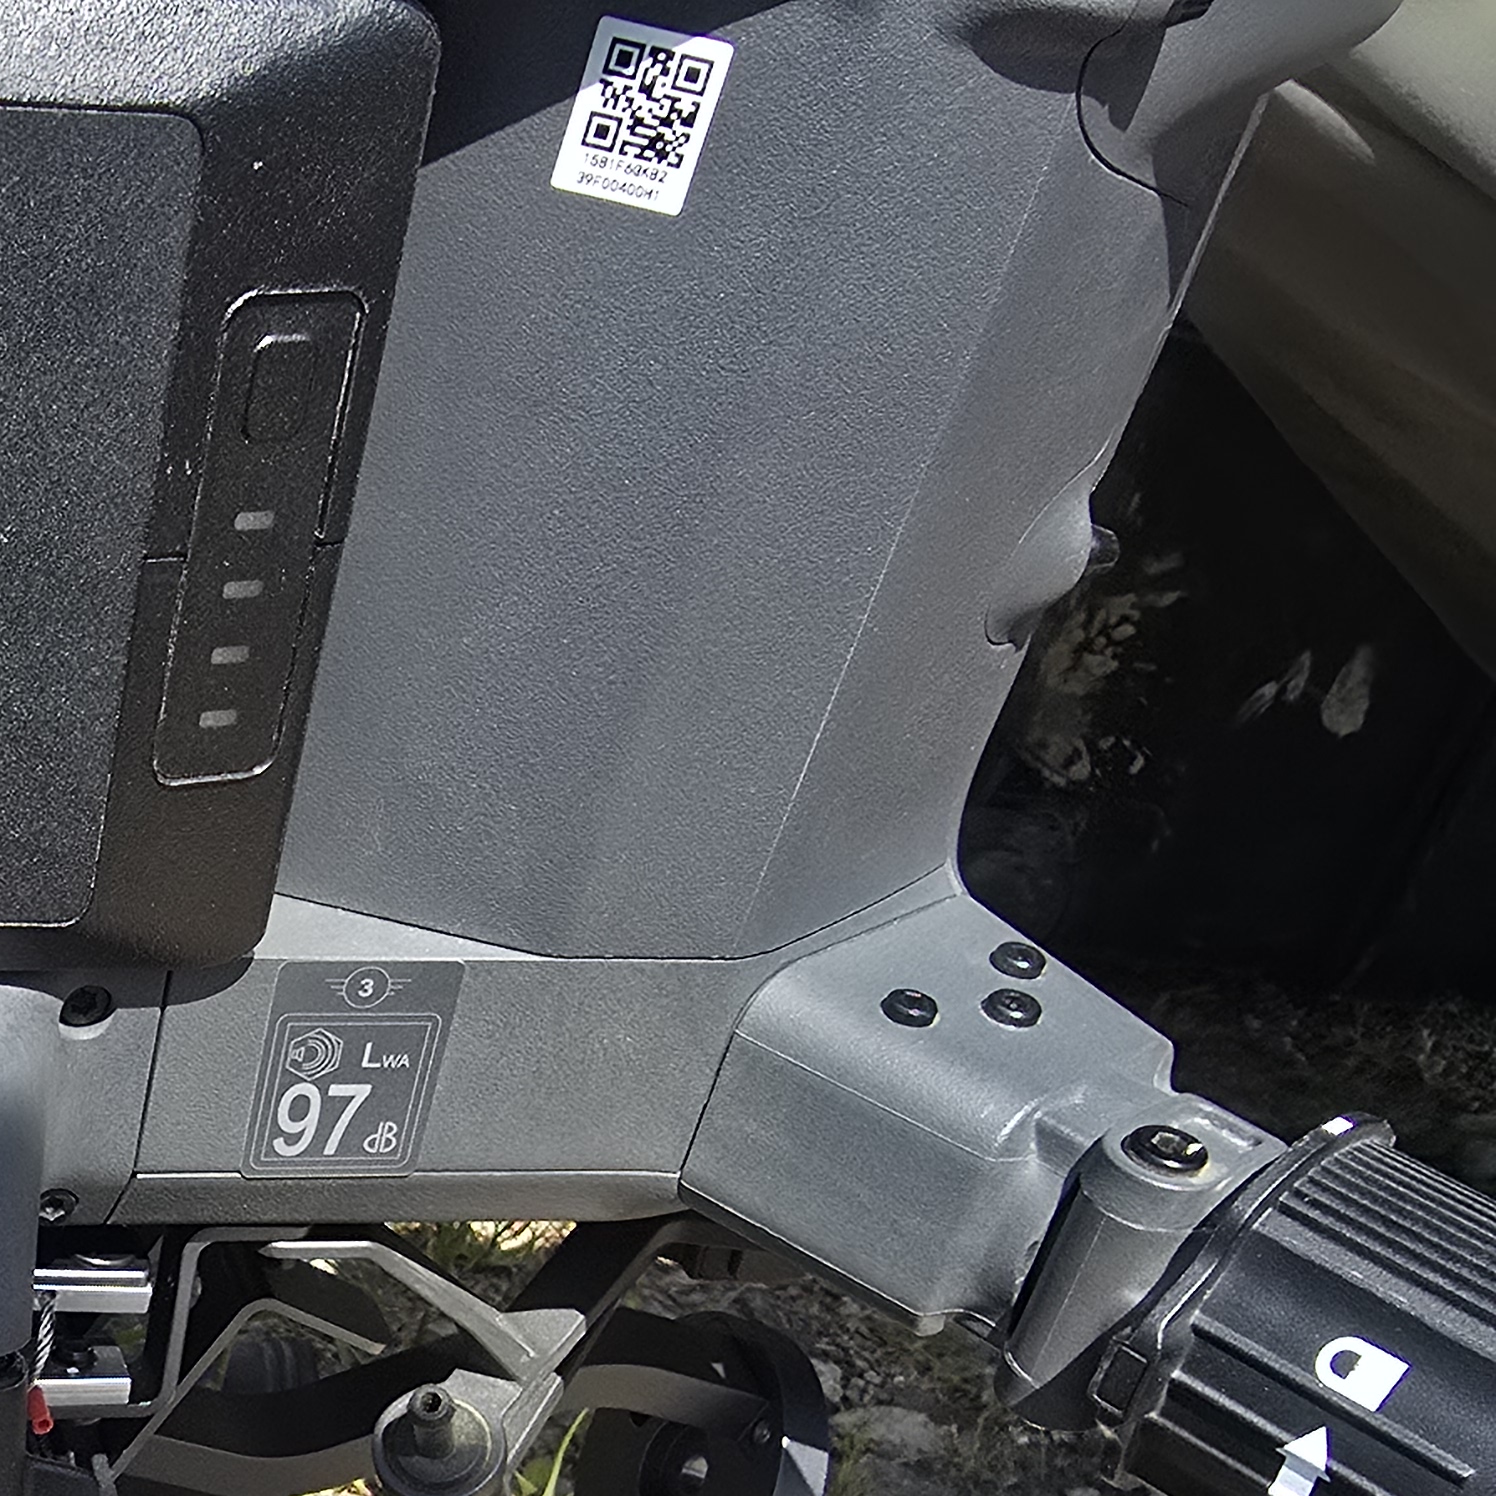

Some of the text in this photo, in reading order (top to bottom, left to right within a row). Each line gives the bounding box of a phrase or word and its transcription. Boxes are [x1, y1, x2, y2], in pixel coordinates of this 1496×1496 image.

[357, 978, 374, 997] 3
[273, 1082, 398, 1157] 97 dB
